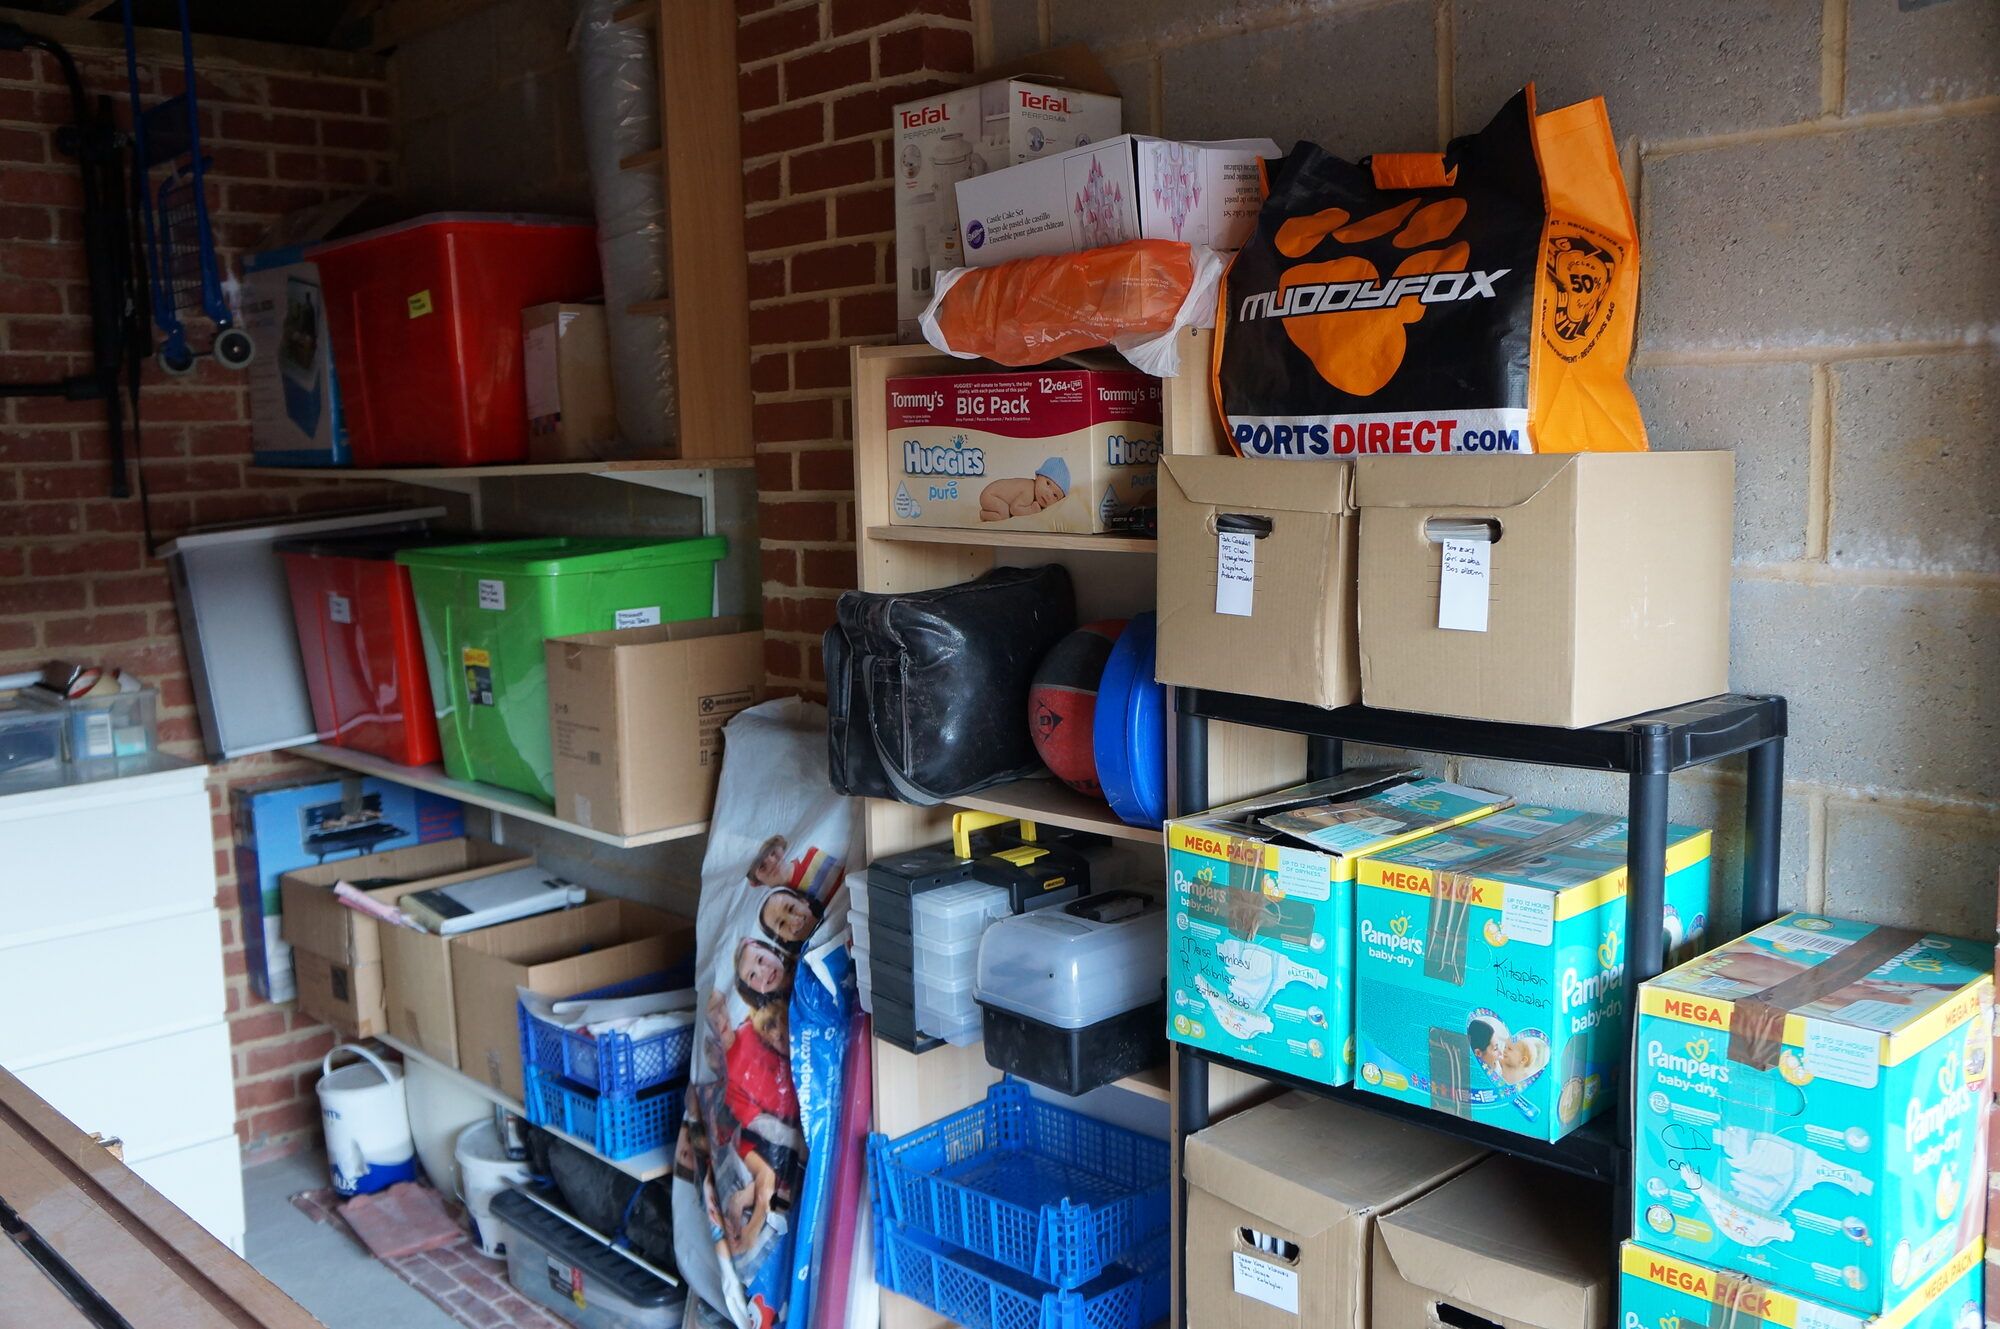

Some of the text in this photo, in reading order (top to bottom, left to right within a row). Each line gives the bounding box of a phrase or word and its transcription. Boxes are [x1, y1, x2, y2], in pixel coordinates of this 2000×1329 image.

[1018, 90, 1072, 114] Tefal
[899, 103, 950, 129] Tefal
[1021, 111, 1067, 123] PERFORMA
[903, 127, 946, 140] PERFORMA
[986, 214, 1001, 224] Castle
[1002, 211, 1014, 220] Cake
[1002, 223, 1008, 231] de
[1024, 217, 1031, 225] de
[989, 232, 1013, 244] Ensemble
[1013, 231, 1026, 240] pour
[1239, 268, 1512, 322] MUDDYFOX
[891, 391, 944, 412] Tommy's
[956, 396, 985, 415] BIG
[990, 395, 1030, 414] Pack
[1097, 387, 1145, 404] Tommy's
[903, 440, 984, 476] HUGGIES
[1107, 435, 1161, 466] HUGG
[928, 485, 958, 501] pure
[1184, 834, 1265, 865] MEGA PACK
[1294, 868, 1321, 877] DRYNESS
[1306, 864, 1327, 872] HOURS
[1174, 869, 1227, 903] Pampers
[1381, 869, 1484, 904] MEGA PACK
[1180, 896, 1219, 916] baby-dry
[1360, 919, 1423, 955] Pampers
[1368, 947, 1414, 968] baby-dry
[1561, 963, 1625, 1015] Pamper
[1571, 1003, 1623, 1034] baby-dry
[1664, 998, 1723, 1025] MEGA
[1648, 1040, 1730, 1083] Pampers
[1657, 1072, 1718, 1098] baby-dry
[1905, 1090, 1970, 1153] Pampers
[1661, 1124, 1711, 1151] CD
[1913, 1129, 1962, 1175] baby-dry
[1649, 1262, 1772, 1317] MEGA PACK
[1924, 1252, 1973, 1300] MEGA PACK
